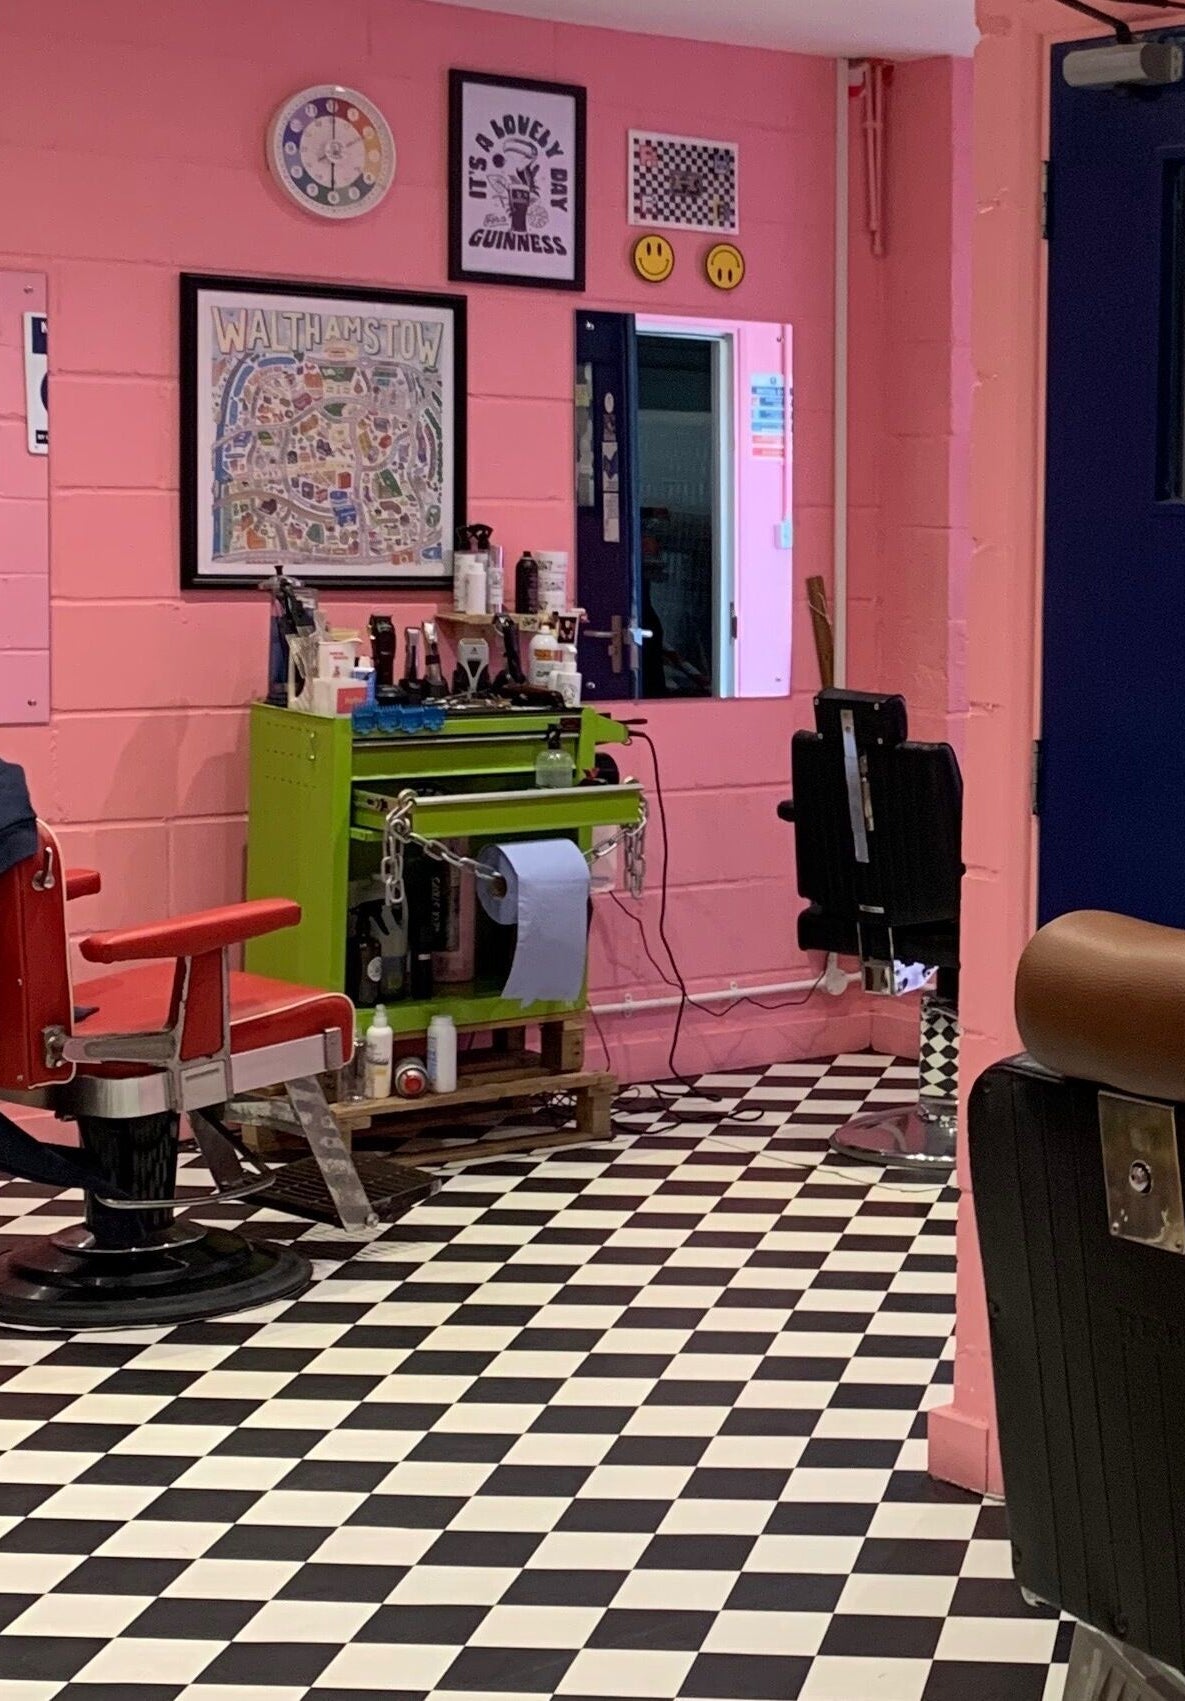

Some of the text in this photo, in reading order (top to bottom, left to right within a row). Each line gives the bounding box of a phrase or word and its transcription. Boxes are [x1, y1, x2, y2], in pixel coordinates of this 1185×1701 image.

[468, 114, 568, 212] IT'S A LOVELY DAY
[468, 228, 567, 256] GUINNESS
[211, 306, 444, 369] WALTHAMSTOW
